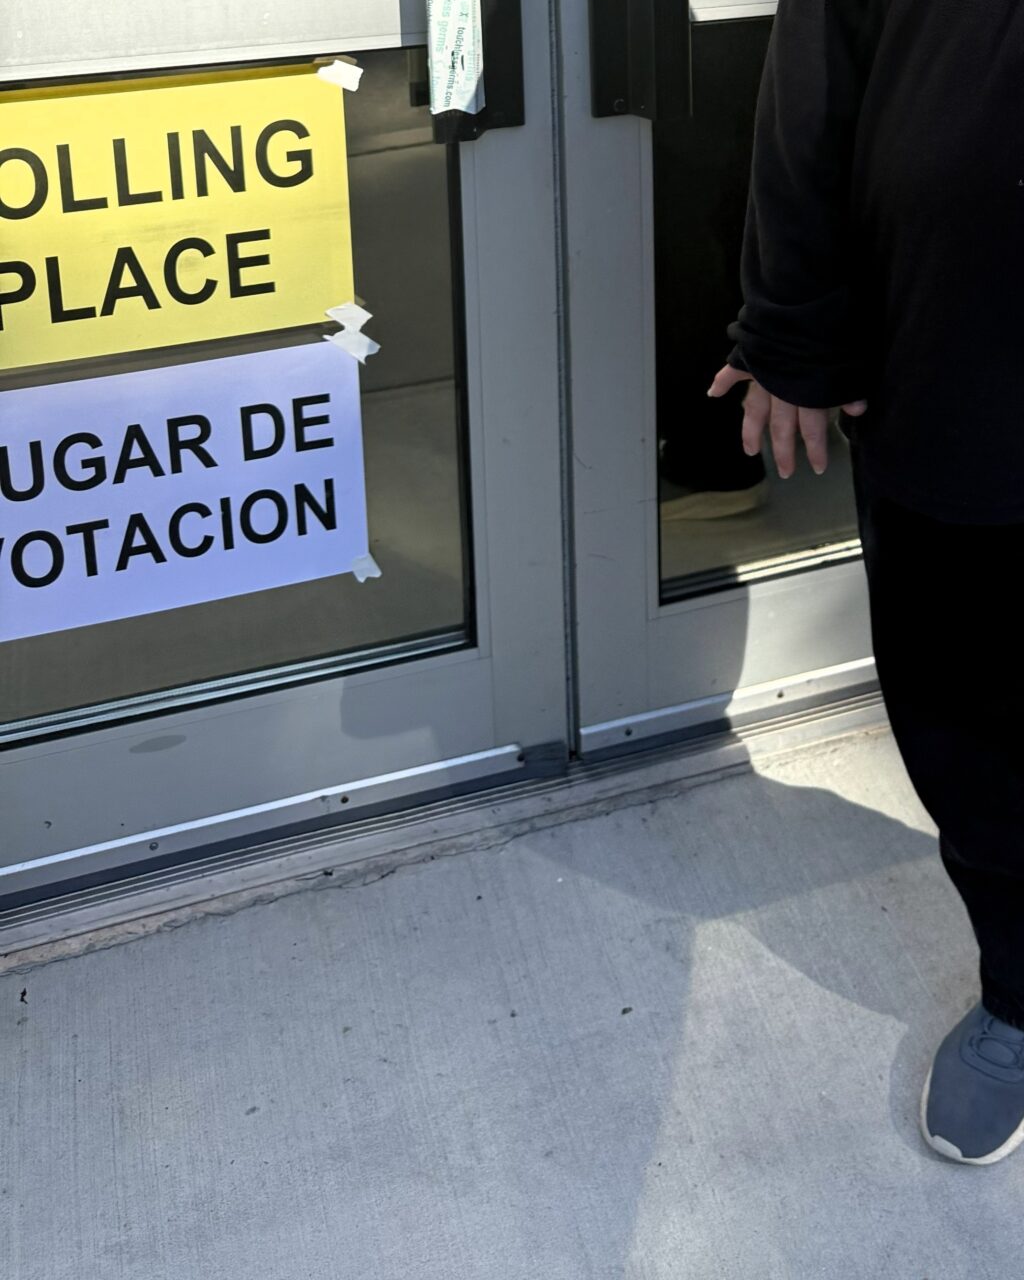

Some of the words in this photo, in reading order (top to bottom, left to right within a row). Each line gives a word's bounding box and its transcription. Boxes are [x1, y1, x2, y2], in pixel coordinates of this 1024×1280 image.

[0, 119, 313, 220] OLLING
[0, 229, 276, 331] PLACE
[0, 414, 218, 501] UGAR
[240, 393, 334, 461] DE
[0, 478, 337, 588] OTACION
